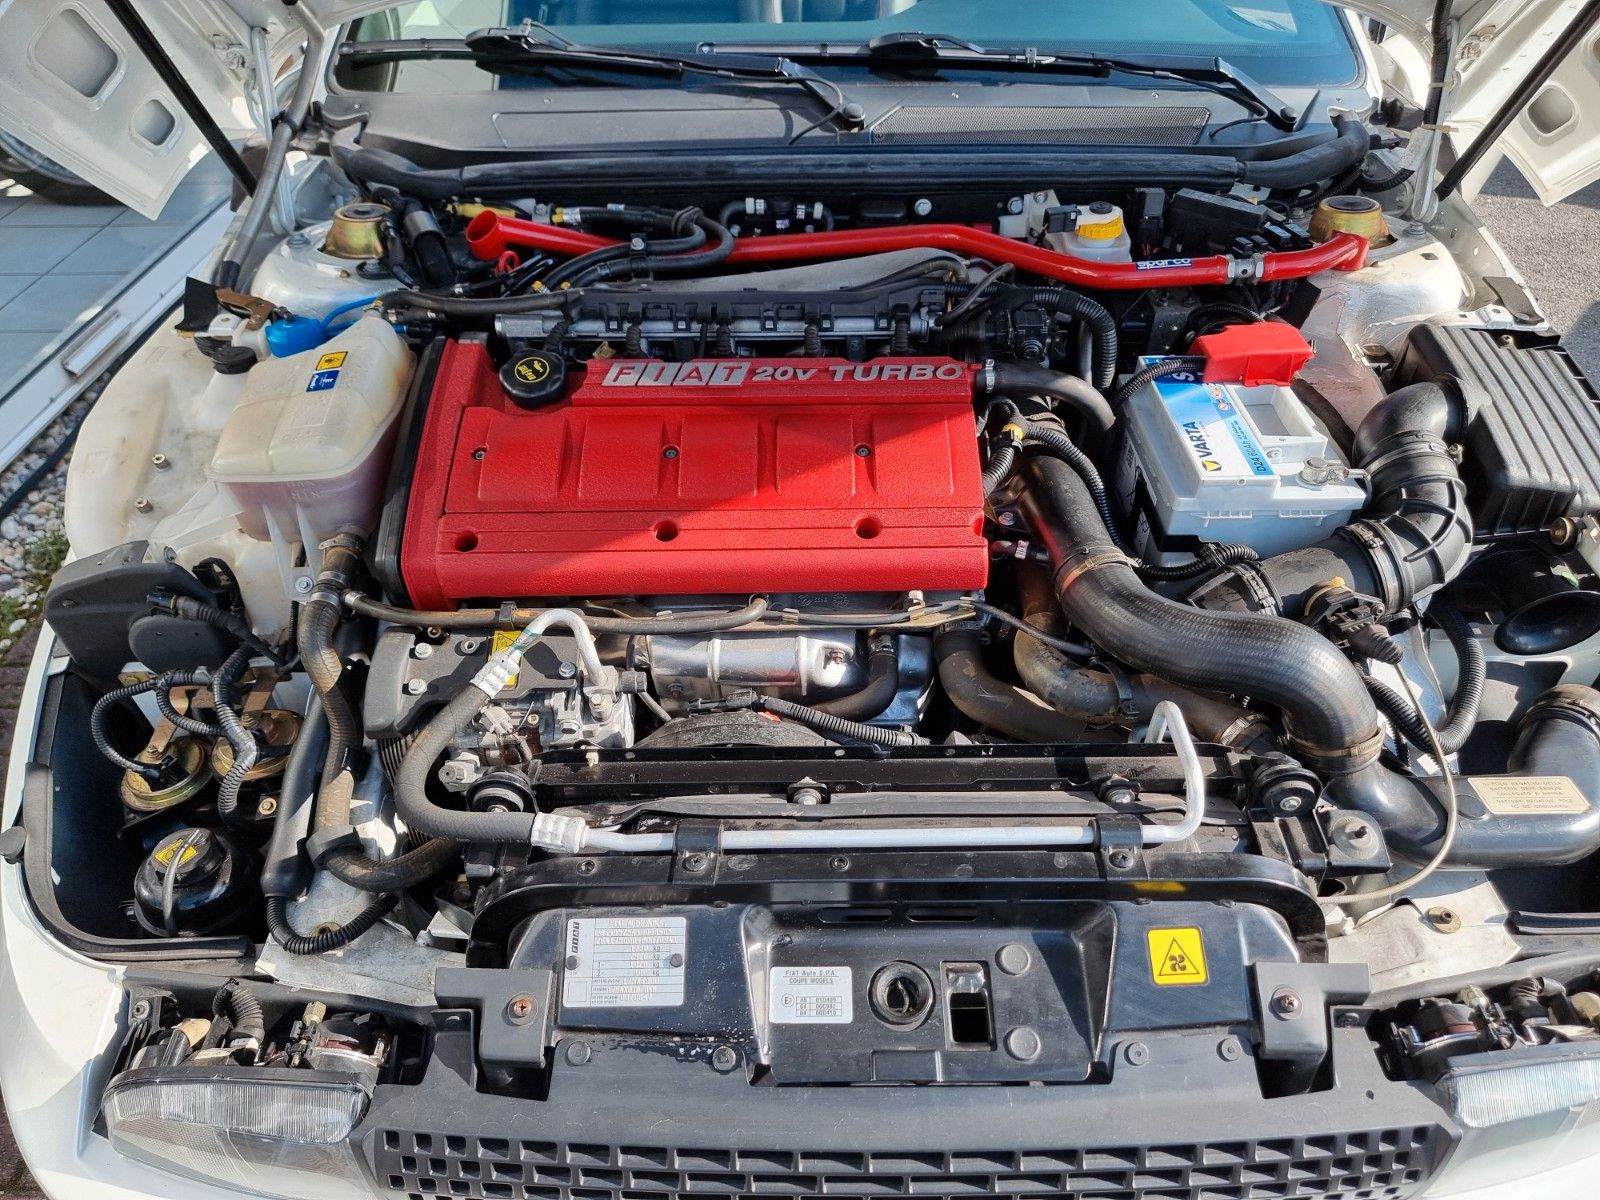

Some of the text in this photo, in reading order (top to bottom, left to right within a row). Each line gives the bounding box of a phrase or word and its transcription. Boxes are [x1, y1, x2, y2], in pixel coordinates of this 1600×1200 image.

[1136, 258, 1191, 269] sparco
[605, 363, 748, 386] FIAT
[828, 364, 964, 382] TURBO
[1182, 421, 1213, 459] VARTA
[571, 921, 580, 954] FIAT
